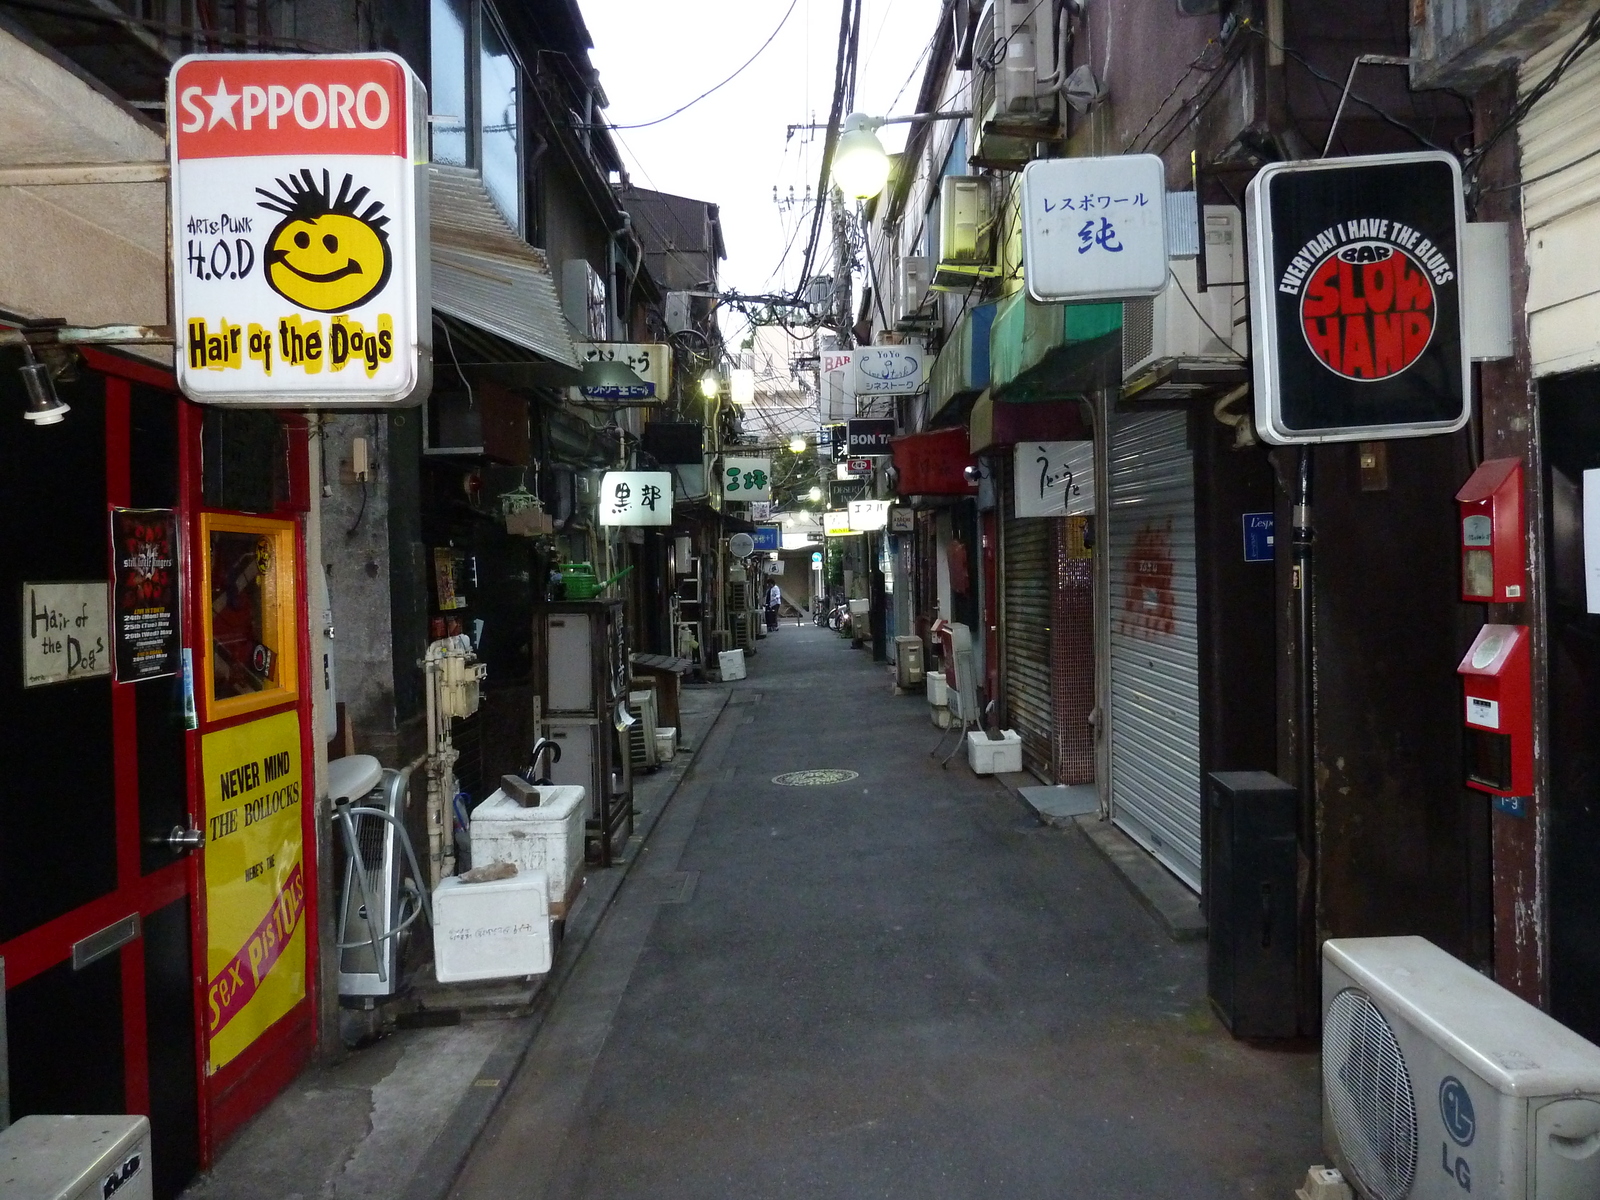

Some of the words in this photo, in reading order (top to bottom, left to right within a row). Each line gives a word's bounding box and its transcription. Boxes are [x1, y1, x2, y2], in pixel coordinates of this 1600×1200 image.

[1043, 192, 1149, 213] レスポワール
[1077, 216, 1124, 254] 純
[1278, 228, 1338, 296] EVERYDAY
[1336, 223, 1348, 243] I
[1348, 218, 1389, 240] HAVE
[1390, 222, 1420, 247] THE
[1415, 238, 1454, 287] BLUES
[1340, 245, 1393, 263] BAR
[1303, 249, 1433, 316] SLOW
[189, 322, 241, 368] Hair
[250, 329, 272, 371] of
[280, 320, 323, 365] the
[331, 322, 392, 371] Dogs
[823, 355, 851, 373] BAR
[1303, 311, 1432, 380] HAND
[865, 381, 914, 391] シネストーク
[850, 434, 876, 446] BON
[30, 588, 70, 639] Hair
[75, 602, 89, 629] of
[41, 635, 62, 656] the
[67, 634, 104, 674] Dogs
[220, 761, 260, 801] NEVER
[264, 751, 290, 785] MIND
[210, 808, 238, 842] THE
[244, 780, 300, 829] BOLLOCKS
[1441, 1141, 1472, 1194] LG
